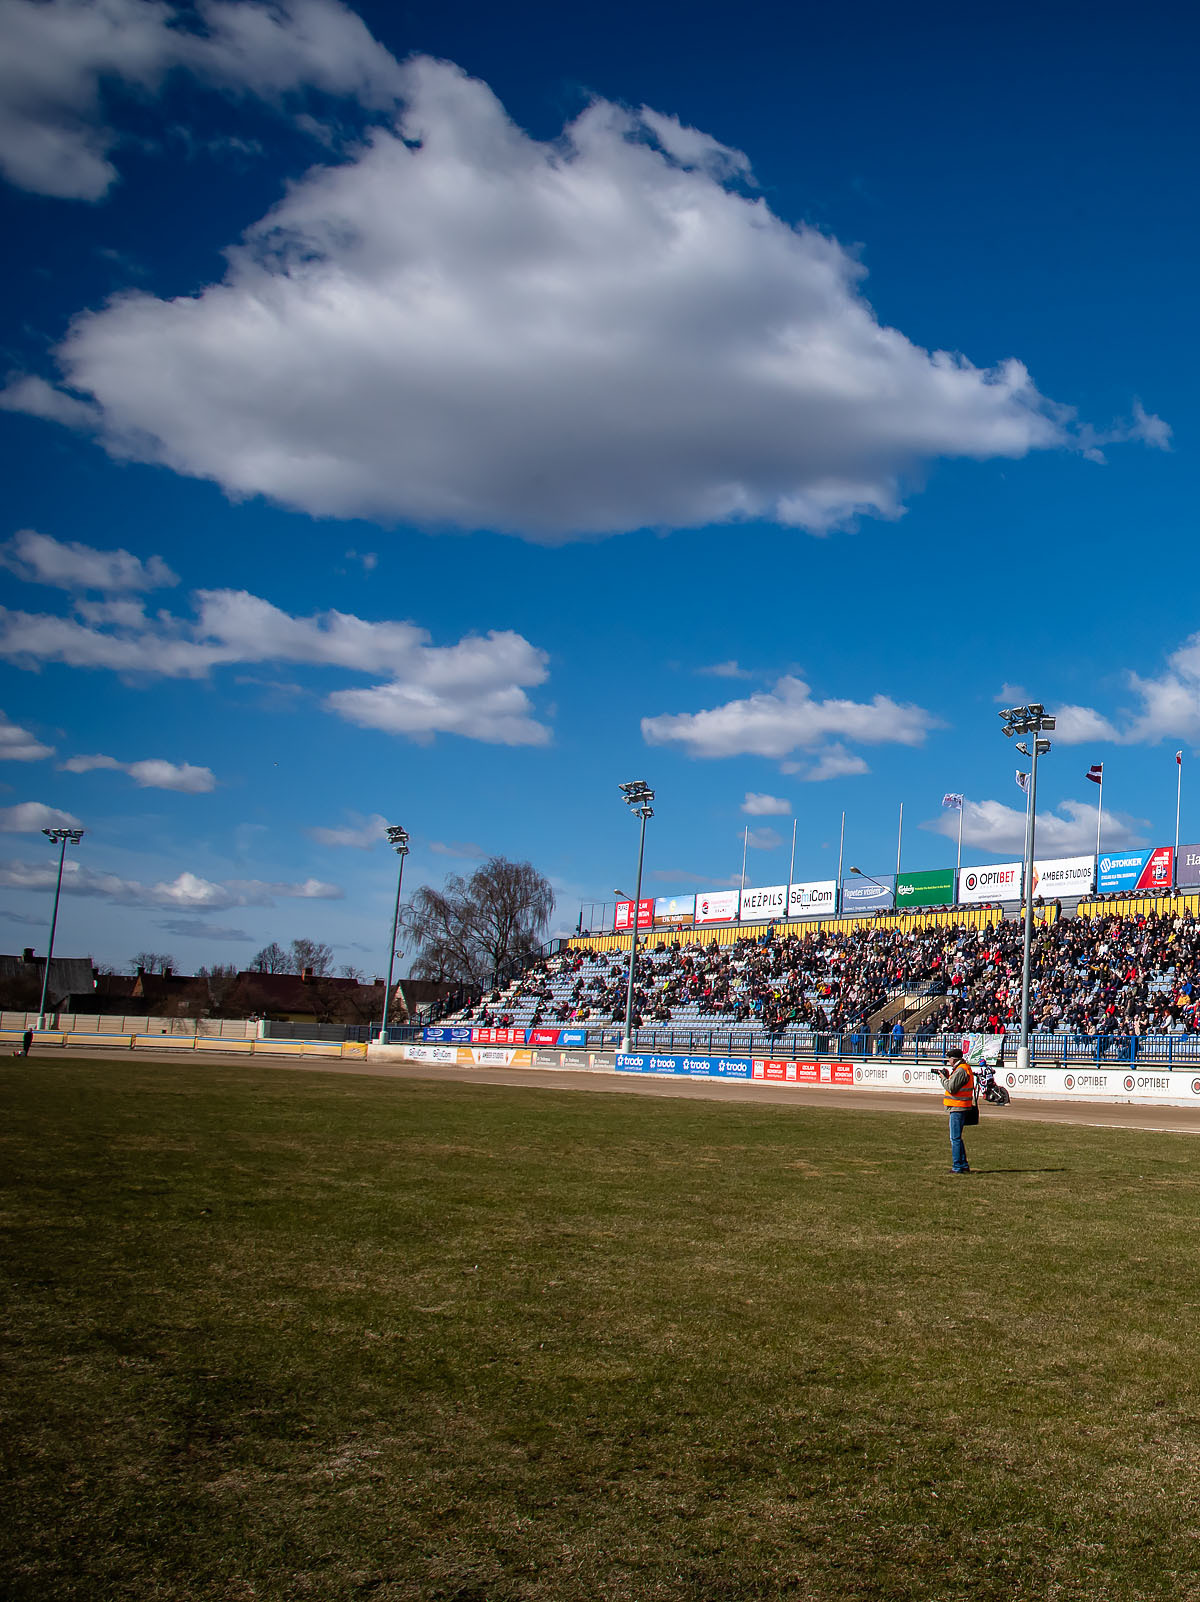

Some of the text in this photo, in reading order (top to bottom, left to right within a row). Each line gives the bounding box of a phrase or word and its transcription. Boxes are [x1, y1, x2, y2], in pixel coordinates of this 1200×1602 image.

[1111, 858, 1142, 868] STOKKER
[980, 871, 1015, 884] OPTIBET
[1042, 870, 1064, 881] AMBER
[1065, 868, 1092, 880] STUDIOS
[743, 892, 783, 908] MEŽPILS
[790, 889, 832, 904] SemiCom
[624, 1056, 643, 1066] trodo
[656, 1059, 675, 1068] trodo
[690, 1060, 710, 1070] trodo
[726, 1062, 747, 1072] trodo
[864, 1069, 888, 1079] OPTIBET
[1017, 1074, 1046, 1085] OPTIBET
[1077, 1075, 1107, 1086] OPTIBET
[1137, 1077, 1170, 1089] OPTIBET
